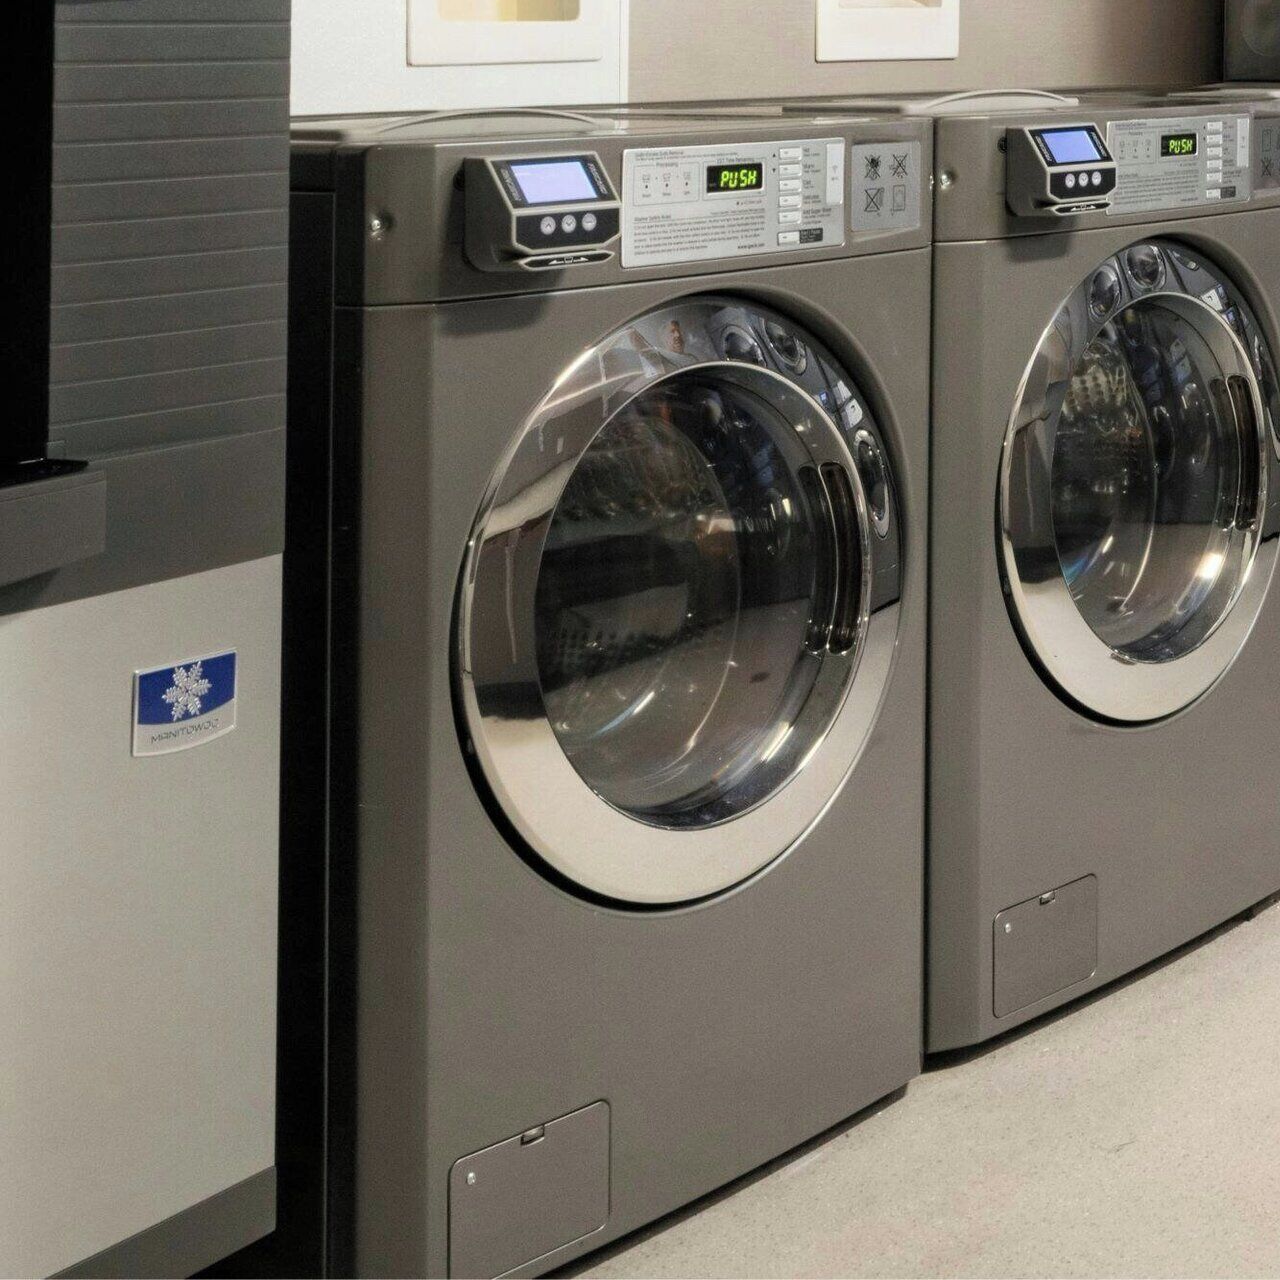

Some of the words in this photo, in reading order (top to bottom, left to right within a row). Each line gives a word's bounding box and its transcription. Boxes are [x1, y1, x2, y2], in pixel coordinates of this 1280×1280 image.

[1169, 139, 1193, 154] PUSH
[720, 169, 757, 189] PUSH
[151, 718, 220, 744] MANITOWOC
